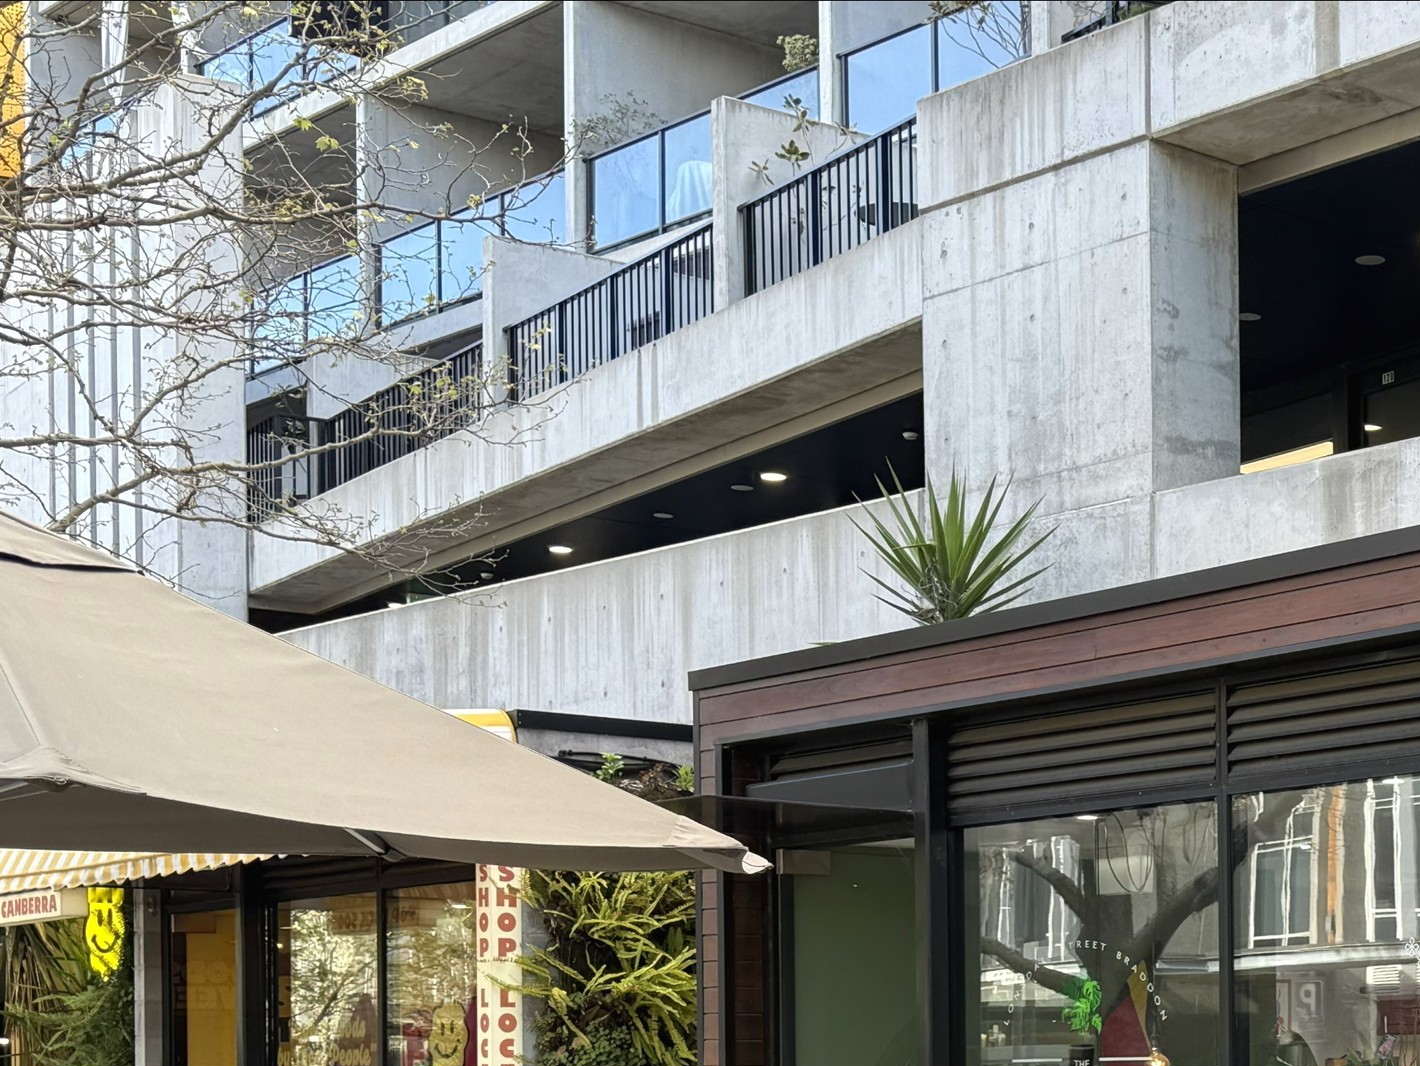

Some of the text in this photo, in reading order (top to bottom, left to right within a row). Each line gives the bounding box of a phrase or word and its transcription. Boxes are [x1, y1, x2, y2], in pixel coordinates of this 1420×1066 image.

[1, 895, 57, 918] CANBERRA
[479, 864, 489, 958] SHOP
[496, 865, 517, 957] SHOP
[1067, 940, 1107, 952] TREET
[1116, 951, 1168, 1021] BRADDON
